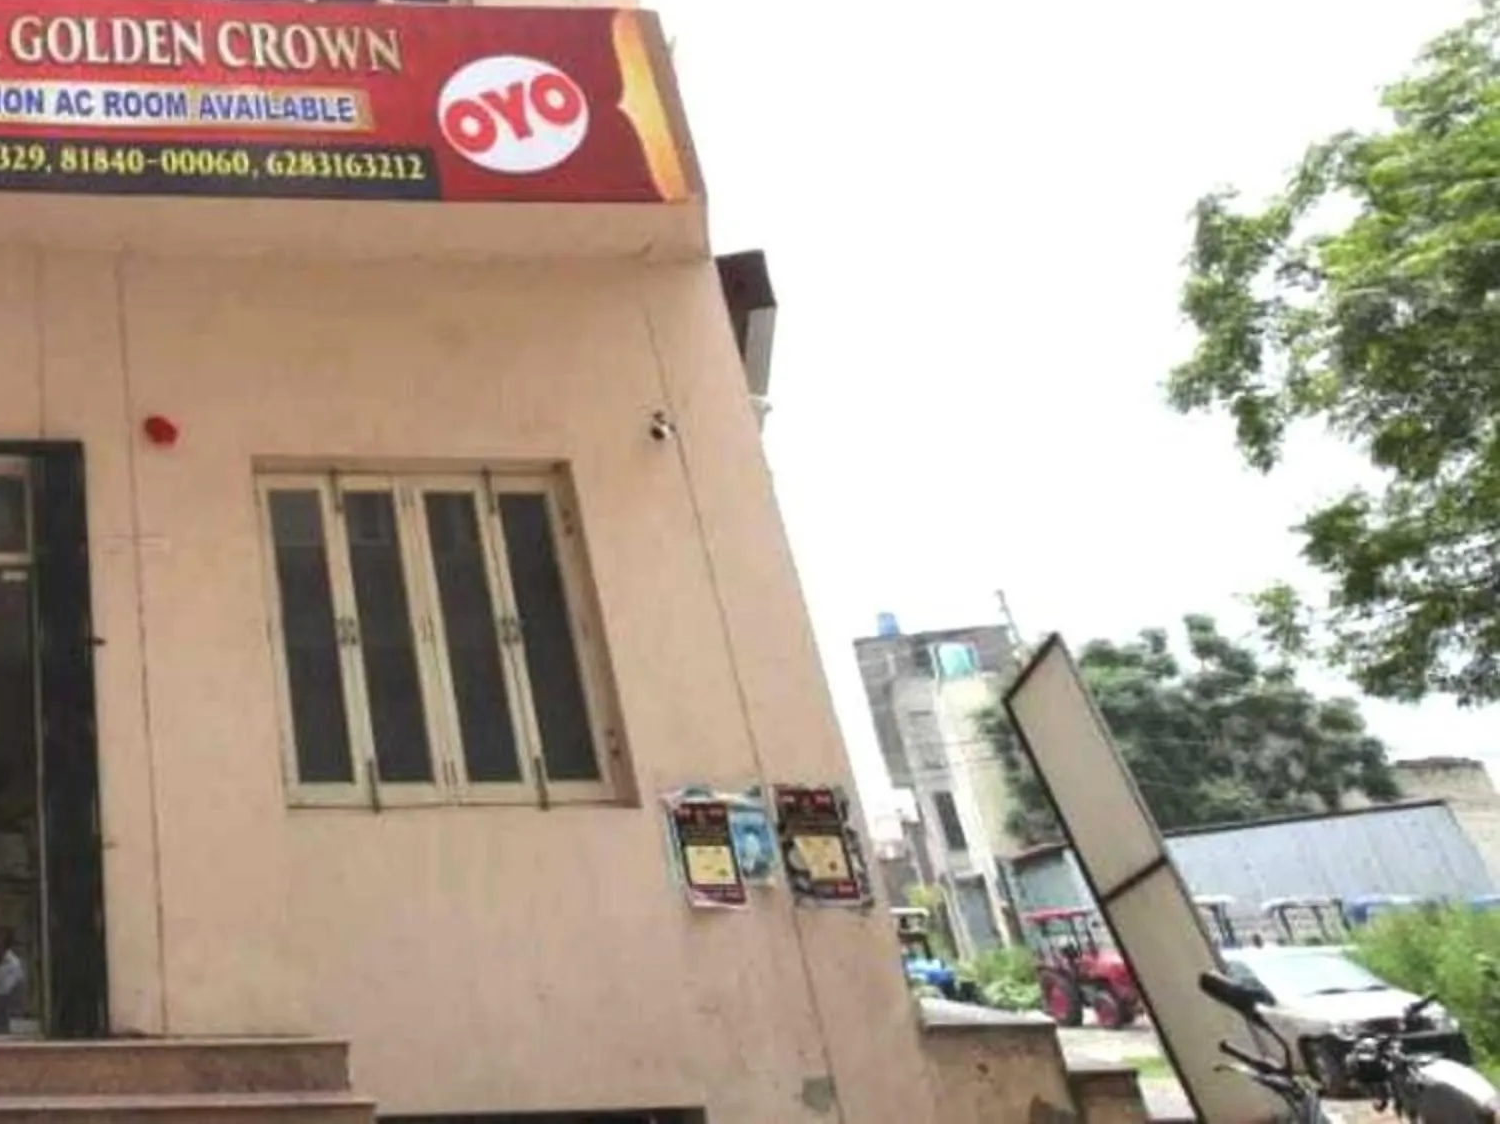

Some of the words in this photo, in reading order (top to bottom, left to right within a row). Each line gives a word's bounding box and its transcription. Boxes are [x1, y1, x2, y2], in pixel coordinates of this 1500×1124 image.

[10, 15, 206, 69] GOLDEN
[217, 19, 403, 76] CROWN
[55, 92, 95, 117] AC
[103, 92, 189, 119] ROOM
[200, 93, 355, 124] AVAILABLE
[443, 73, 583, 155] OYO
[266, 150, 426, 181] 6283163212
